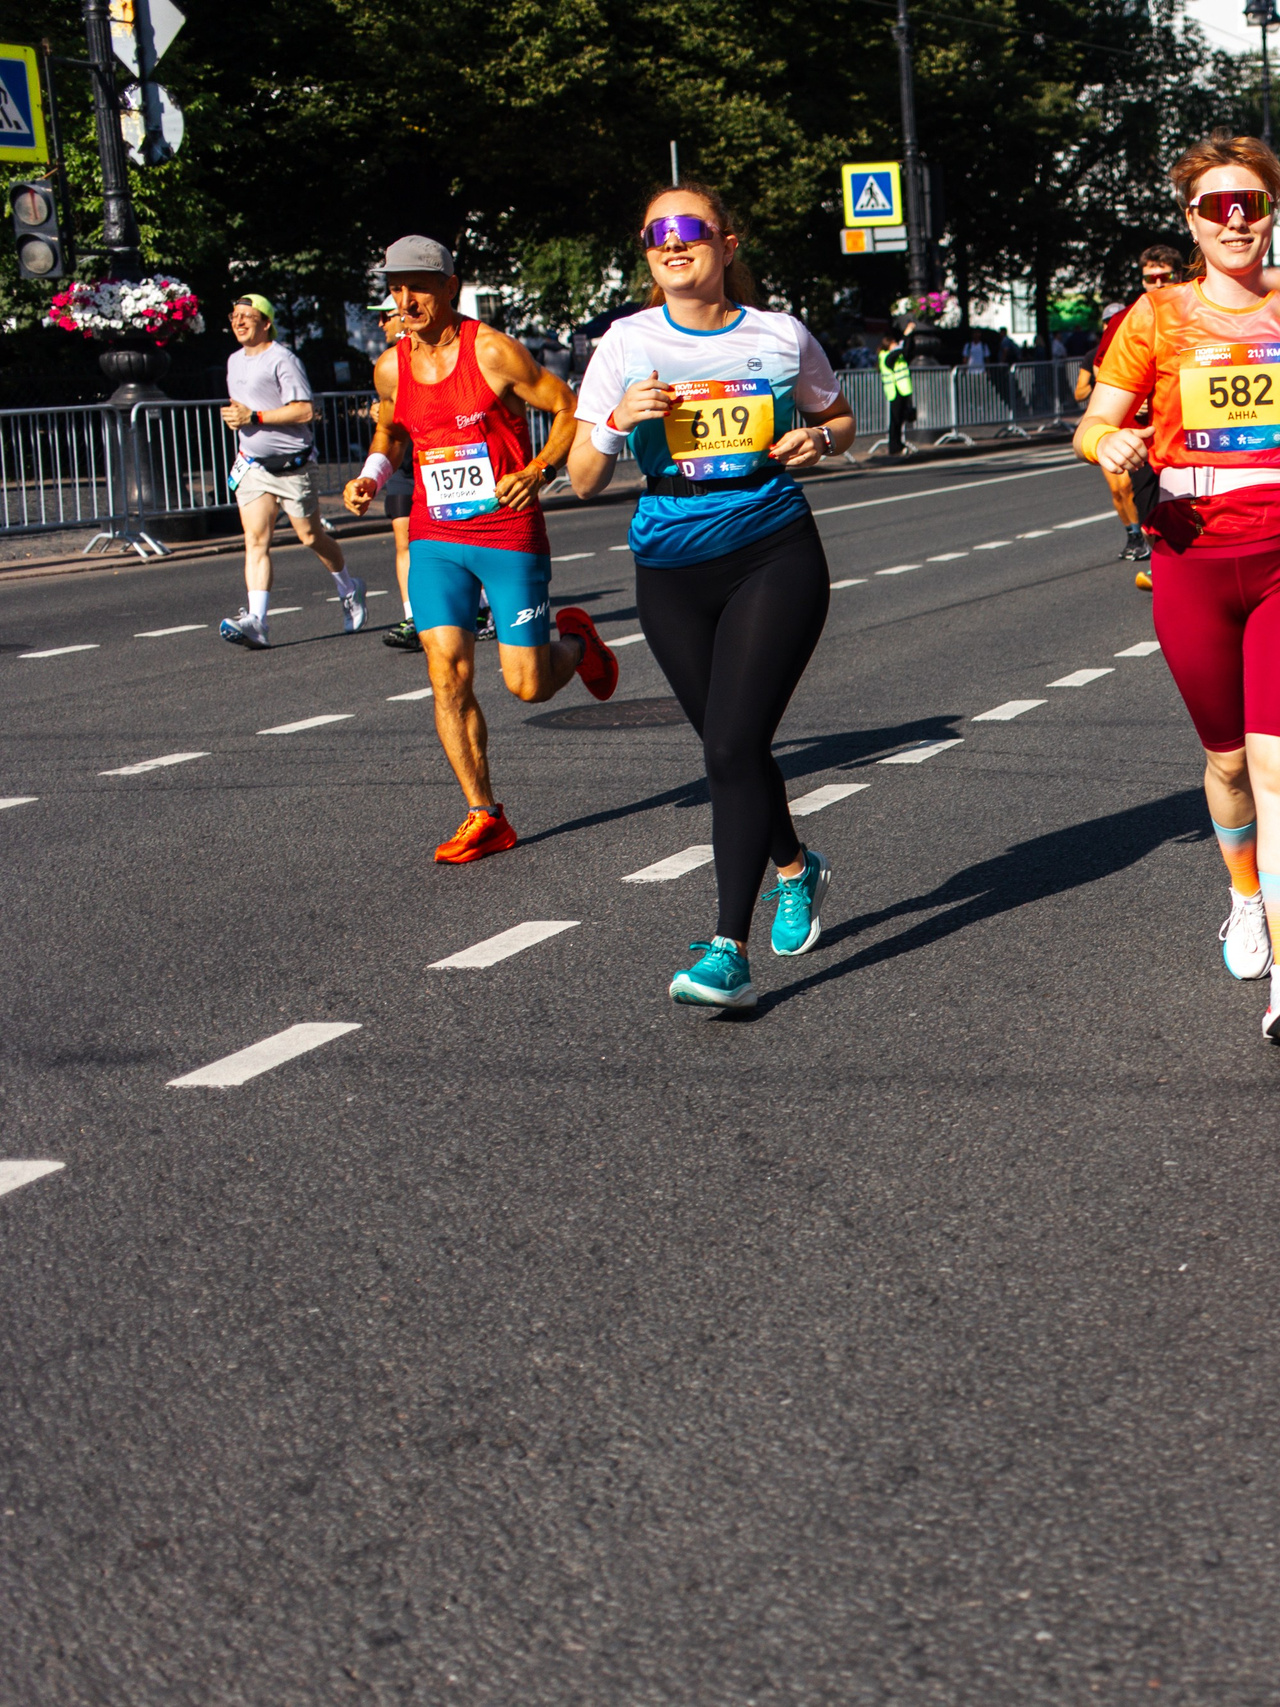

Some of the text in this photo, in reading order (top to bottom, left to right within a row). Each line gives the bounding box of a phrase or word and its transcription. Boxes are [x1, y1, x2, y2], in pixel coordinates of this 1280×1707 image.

[1248, 348, 1264, 358] 21,1
[724, 383, 757, 393] 21,1 КМ
[1209, 373, 1274, 408] 582
[691, 405, 750, 438] 619
[1228, 410, 1258, 420] АННА
[693, 437, 754, 451] АНАСТАСИЯ
[1196, 432, 1210, 449] D
[682, 461, 696, 477] D
[431, 465, 483, 491] 1578
[433, 506, 443, 519] E
